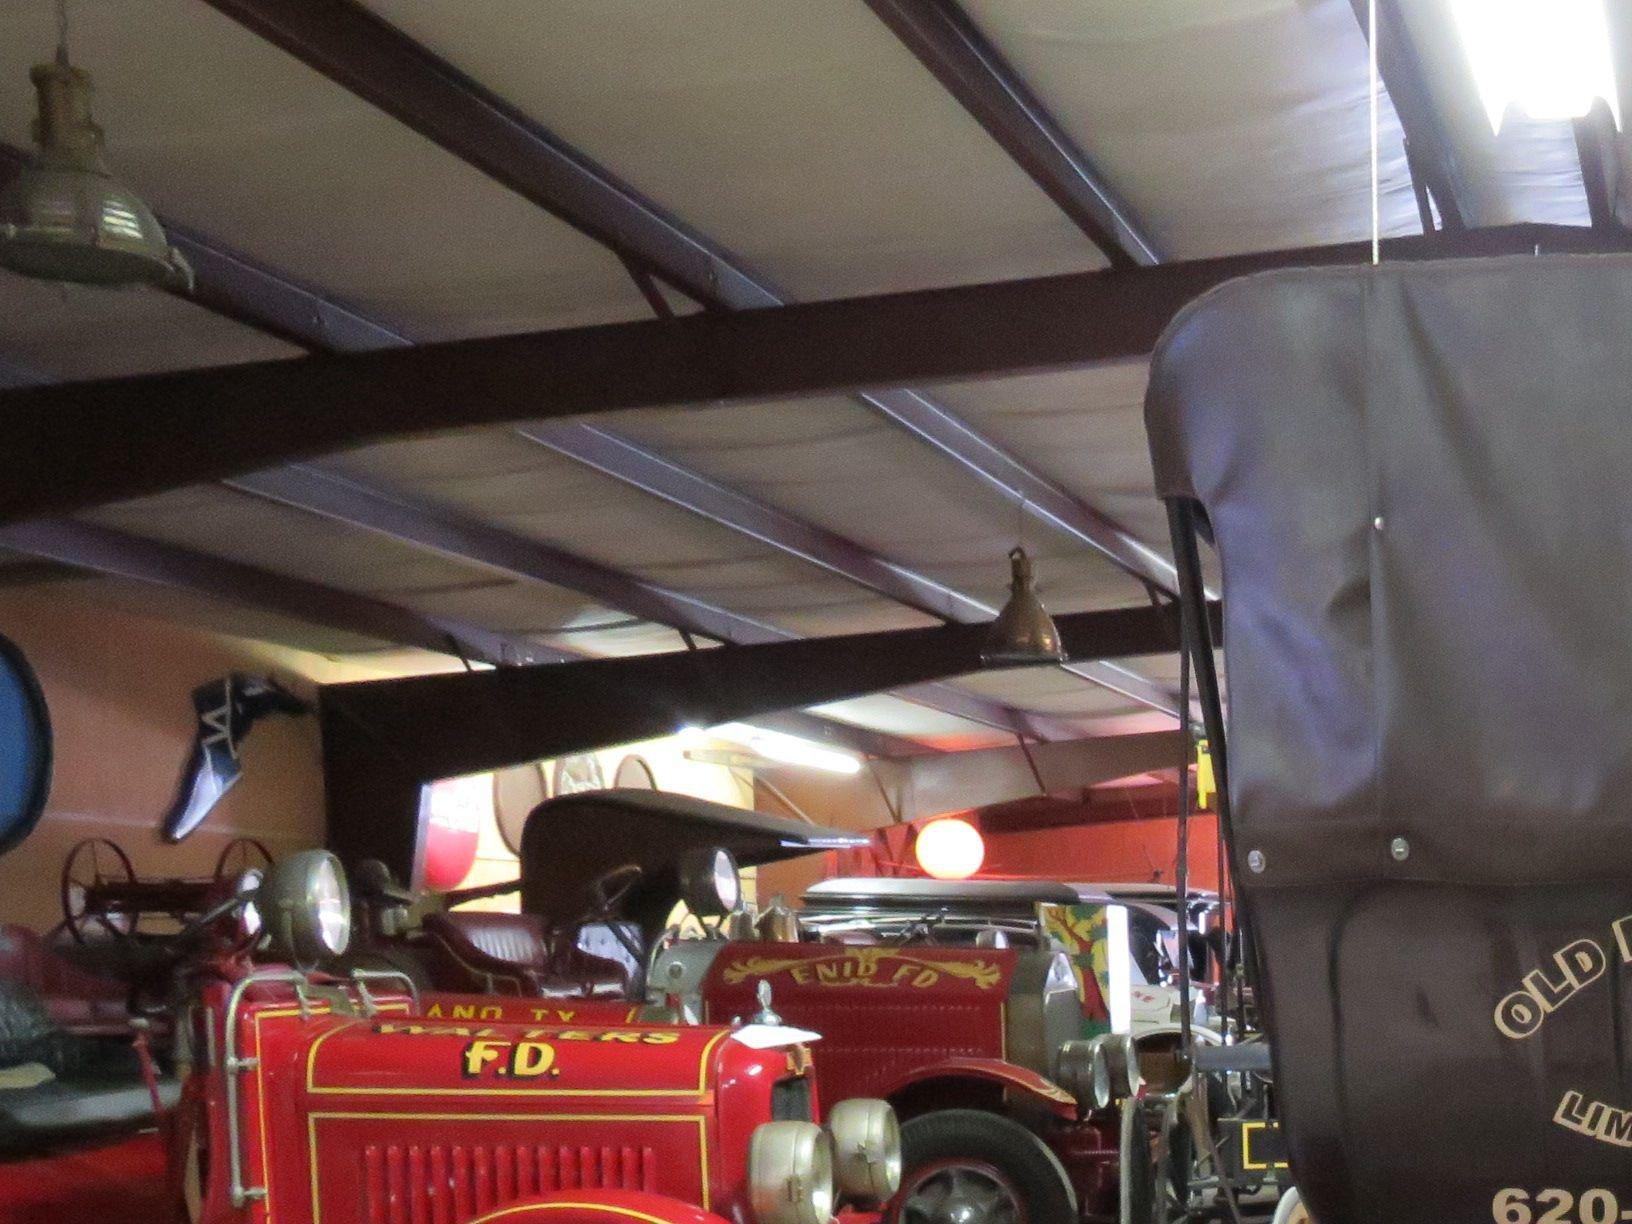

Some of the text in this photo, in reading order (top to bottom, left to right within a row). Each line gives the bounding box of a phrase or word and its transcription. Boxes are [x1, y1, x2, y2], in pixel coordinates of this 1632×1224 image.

[790, 960, 939, 988] ENID FD
[1494, 938, 1606, 1039] OLD
[463, 1040, 560, 1078] F.D.
